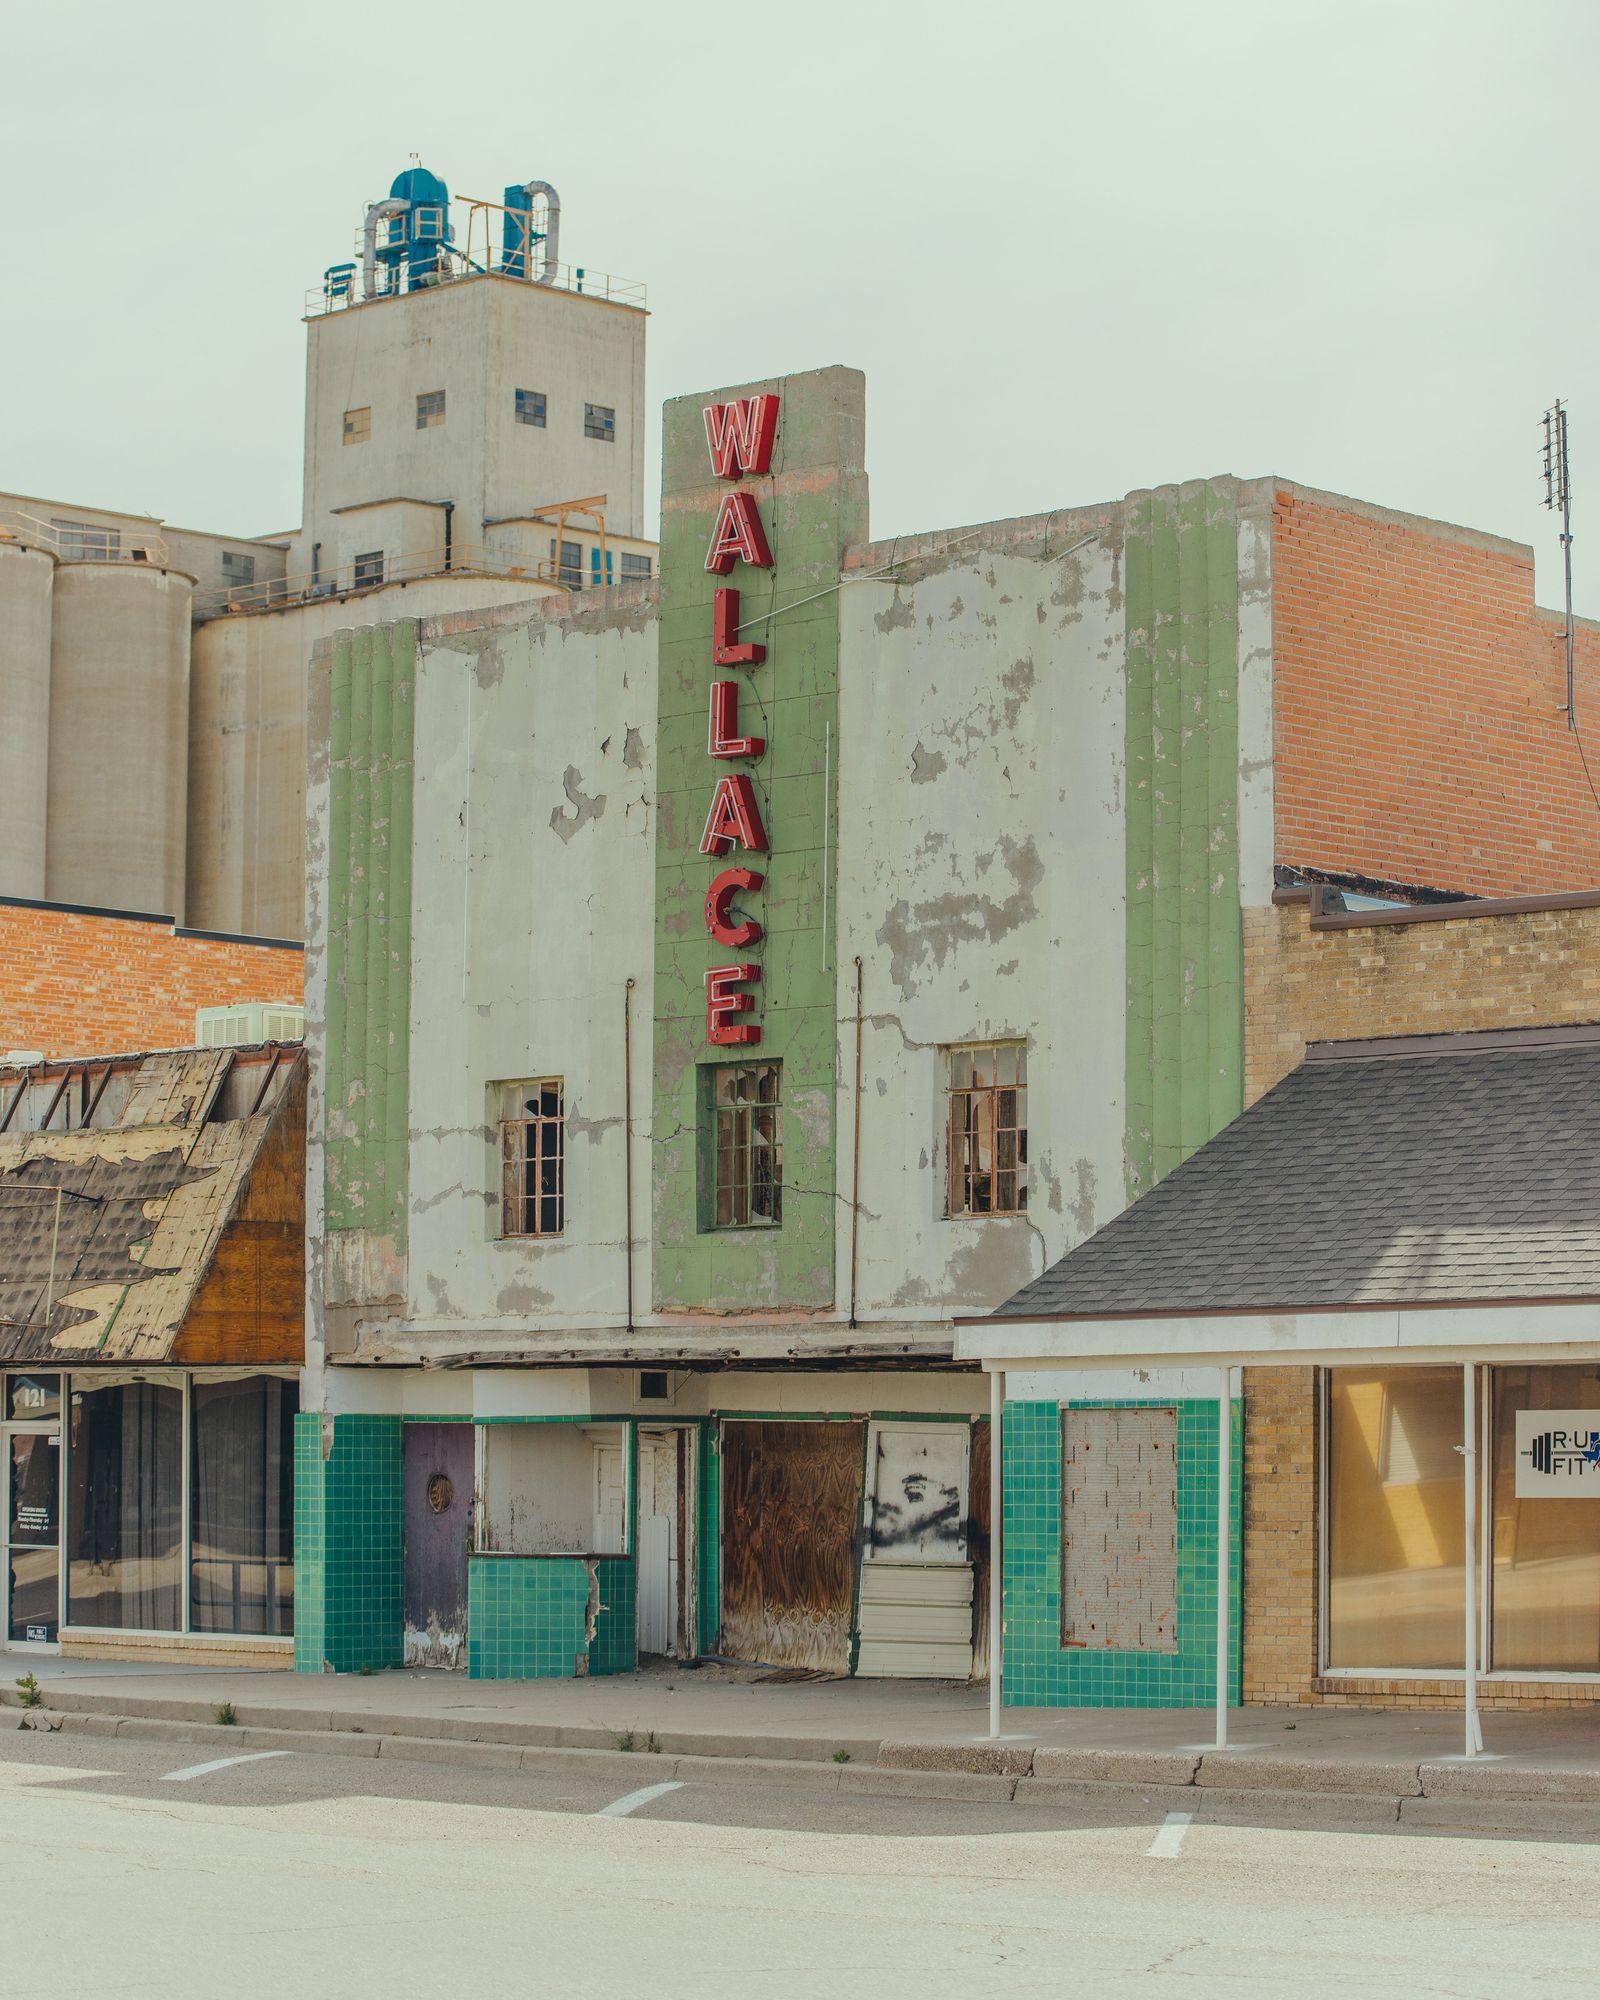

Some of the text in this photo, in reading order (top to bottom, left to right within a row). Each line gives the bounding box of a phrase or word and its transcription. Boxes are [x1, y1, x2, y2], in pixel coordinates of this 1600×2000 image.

[700, 394, 780, 1046] WALLACE
[24, 1388, 45, 1407] 121
[1553, 1458, 1587, 1475] FIT
